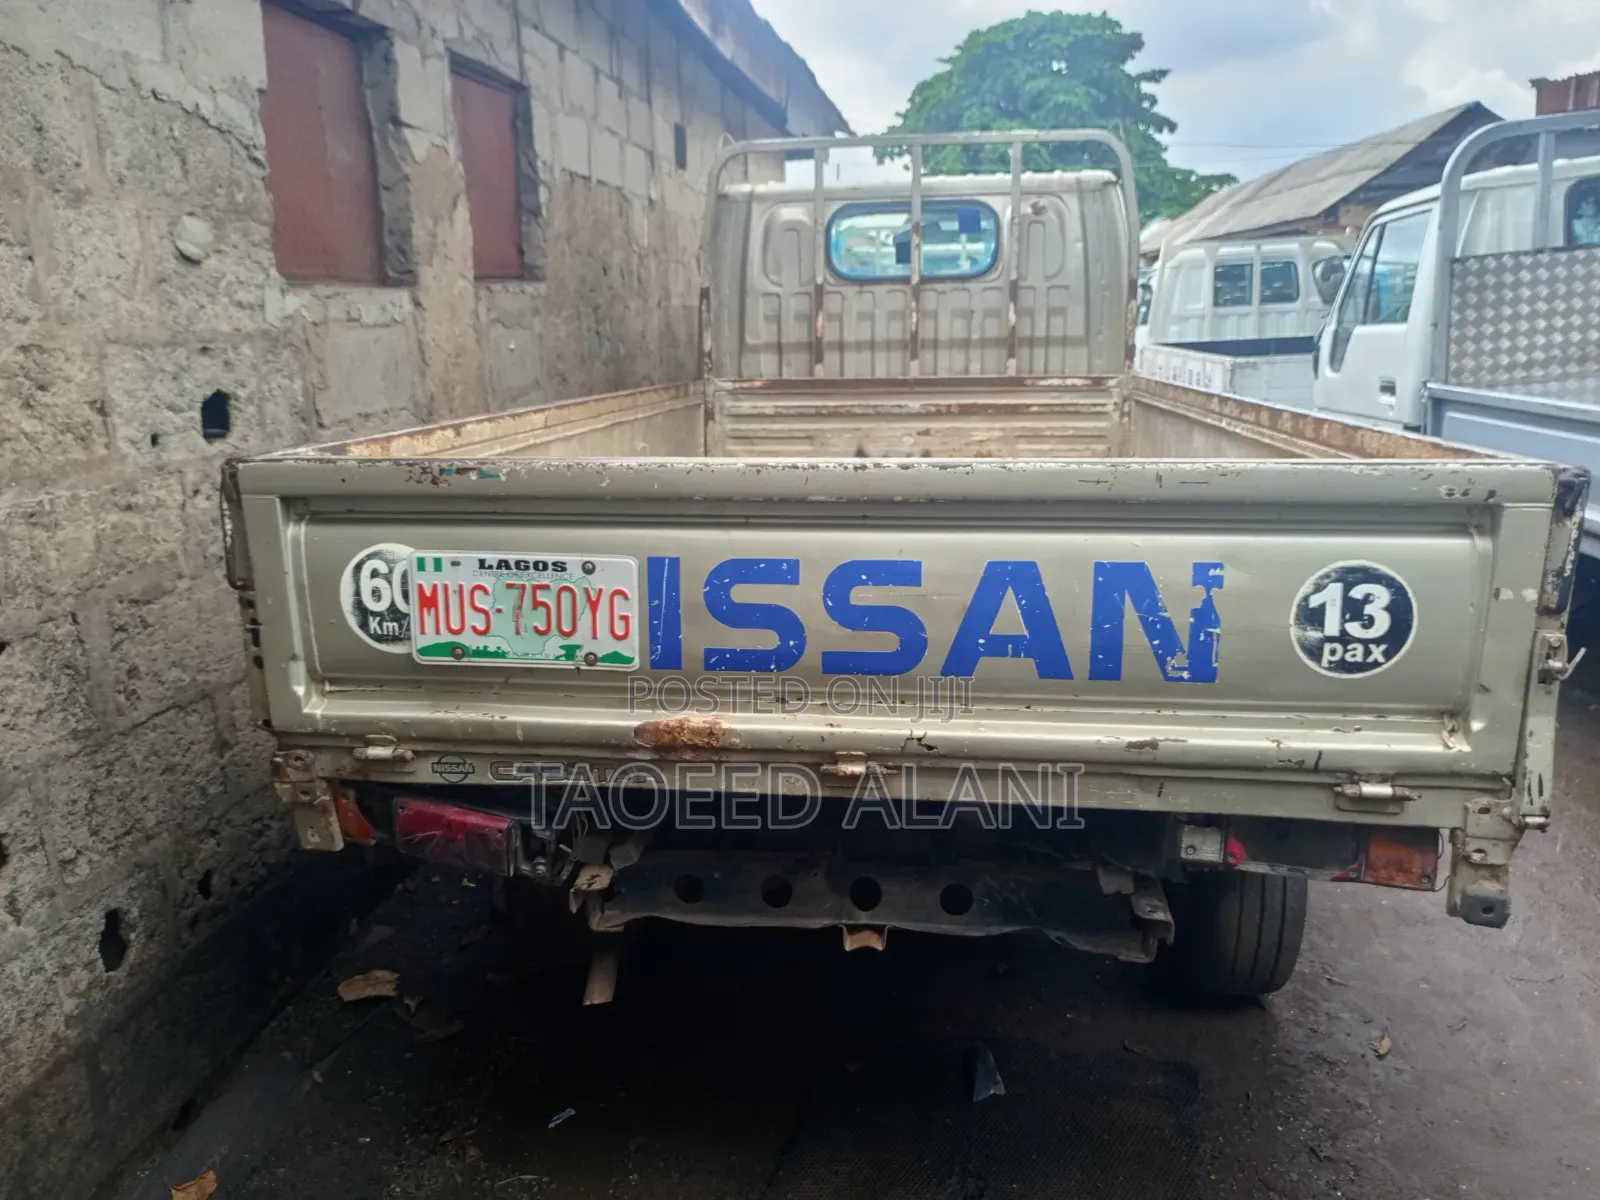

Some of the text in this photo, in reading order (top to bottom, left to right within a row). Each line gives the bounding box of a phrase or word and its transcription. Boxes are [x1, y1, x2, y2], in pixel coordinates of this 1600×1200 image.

[472, 569, 505, 578] CENTRE
[521, 571, 575, 580] EXCELLENCE
[477, 558, 568, 573] LAGOS
[646, 556, 1225, 683] ISSAN
[1308, 582, 1392, 639] 13
[368, 615, 410, 638] Km/
[1321, 641, 1388, 668] pax
[432, 763, 475, 774] NISSAN
